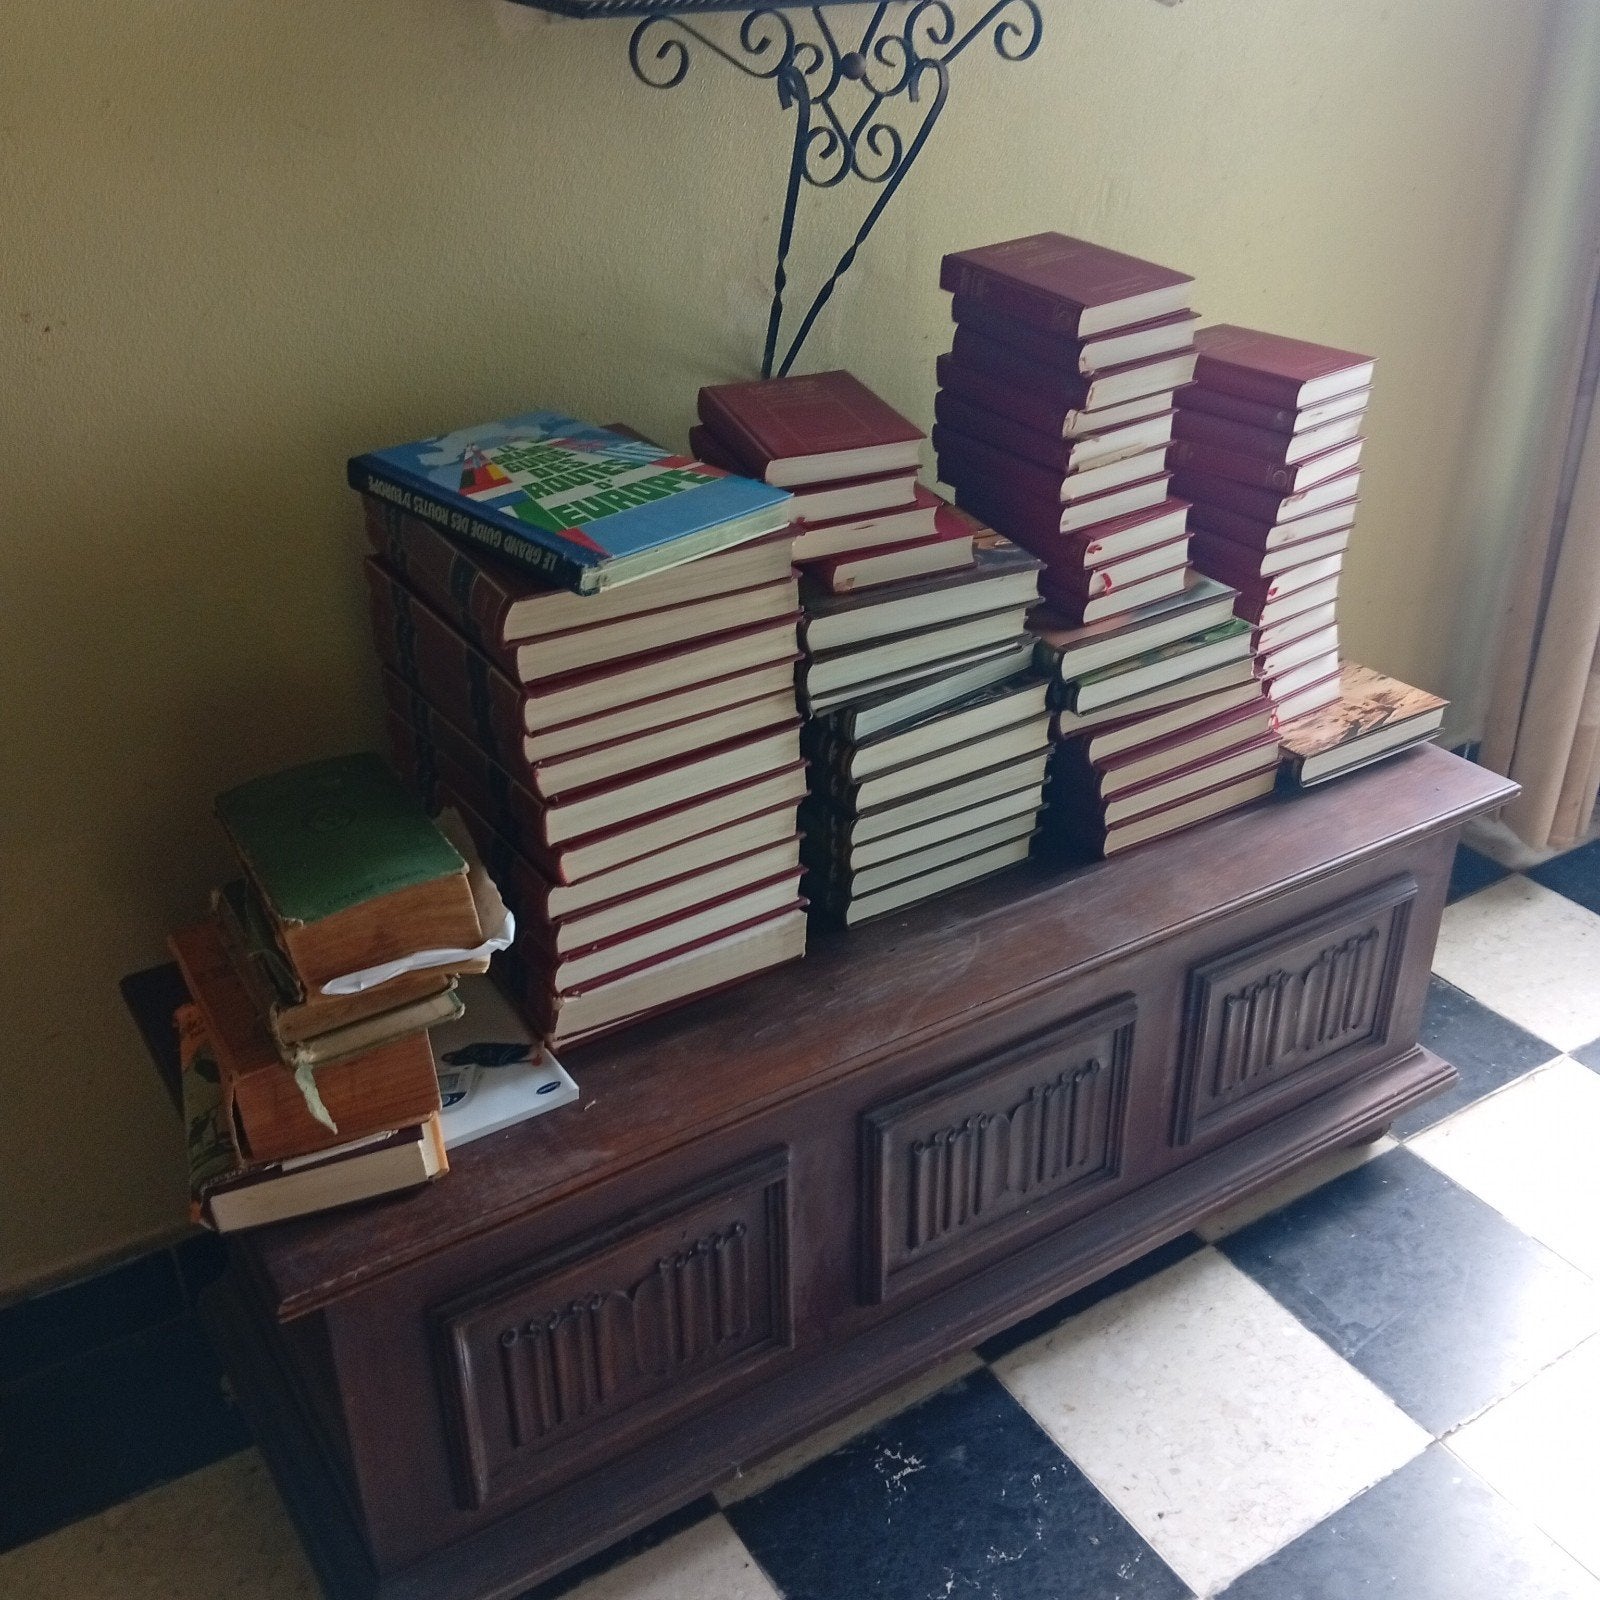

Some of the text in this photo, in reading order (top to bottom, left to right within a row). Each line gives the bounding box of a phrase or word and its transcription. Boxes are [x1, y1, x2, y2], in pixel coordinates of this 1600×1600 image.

[503, 450, 577, 473] GUIDE
[528, 460, 589, 479] DES
[521, 459, 640, 500] ROUTES
[414, 496, 449, 525] ROUTES
[548, 470, 720, 528] EUROPE
[451, 513, 470, 534] DES
[471, 520, 502, 548] GUIDE
[504, 535, 542, 565] GRAND
[542, 552, 558, 571] LE
